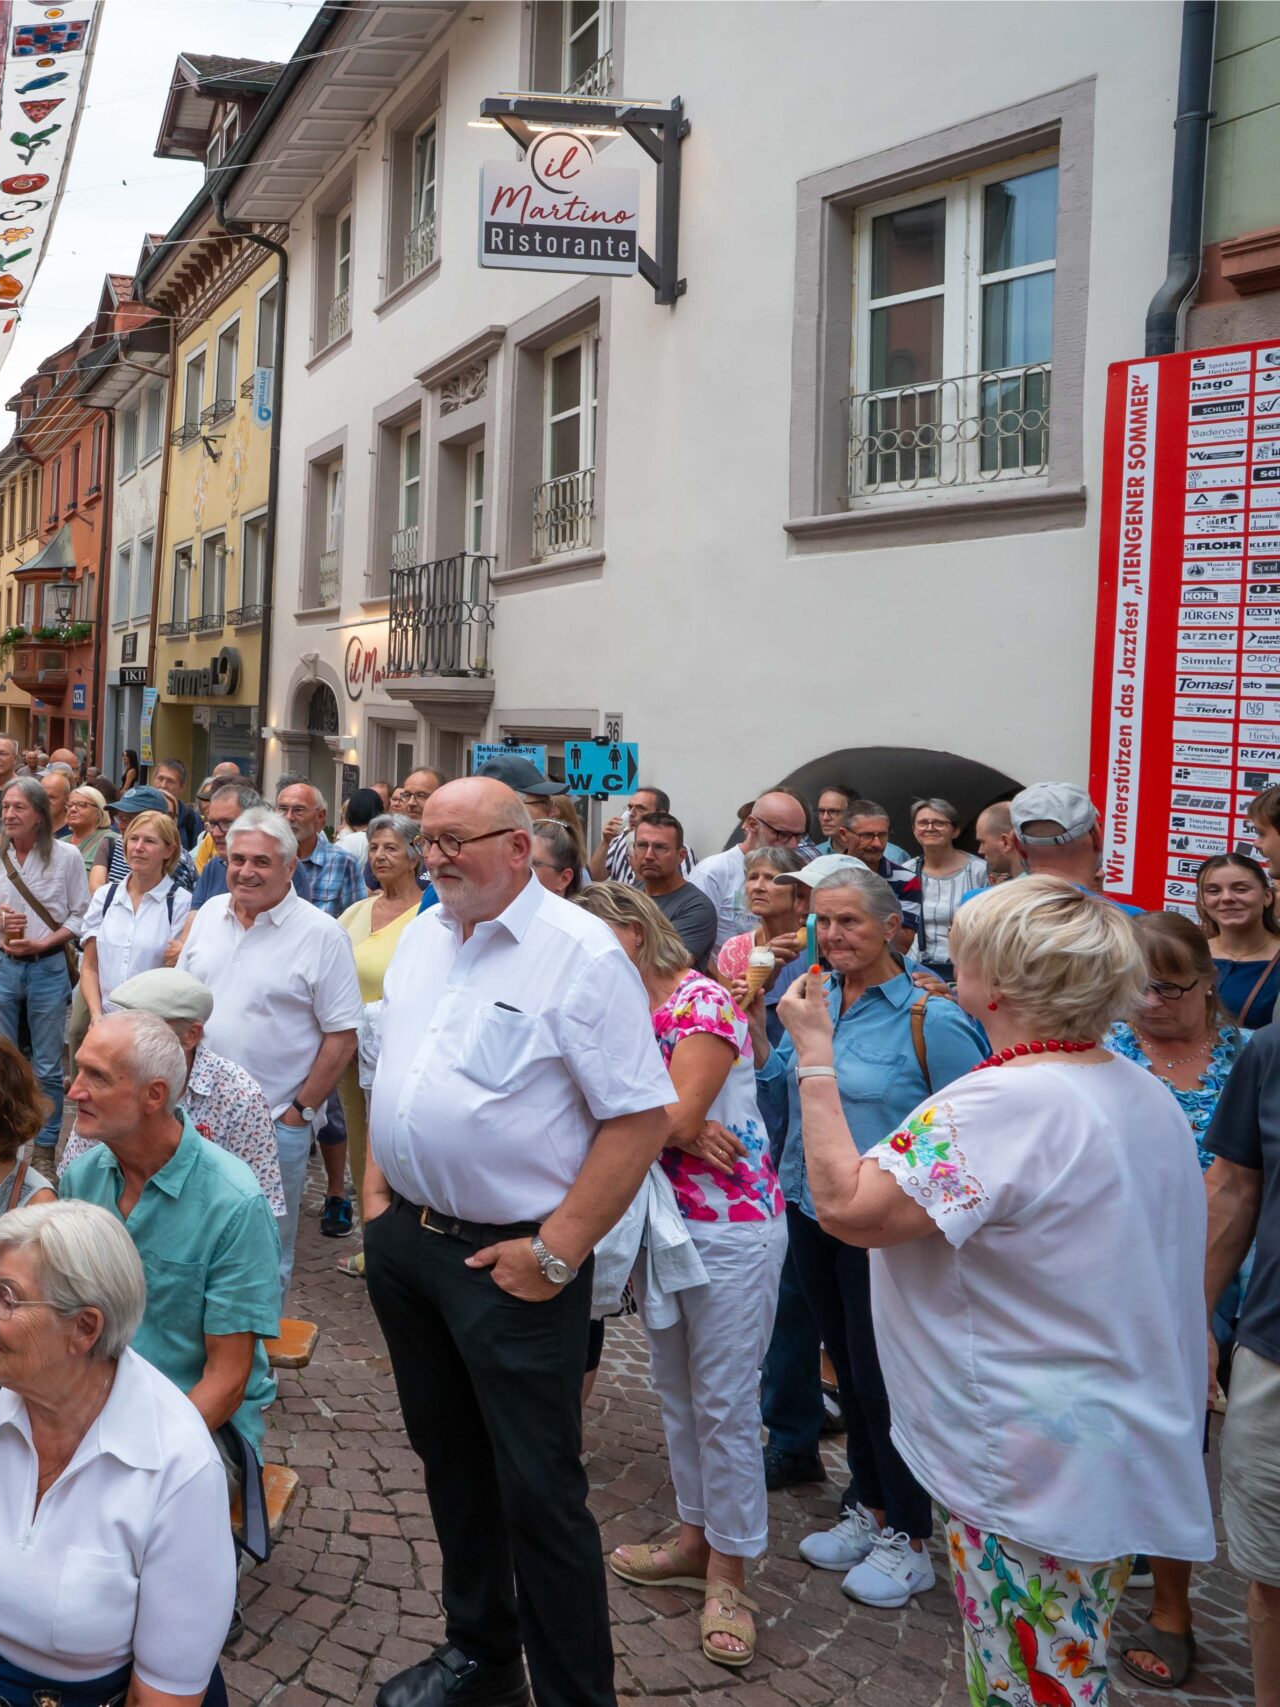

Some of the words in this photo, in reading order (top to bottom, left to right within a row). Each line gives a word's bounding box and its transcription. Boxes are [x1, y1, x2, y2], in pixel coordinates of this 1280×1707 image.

[544, 146, 580, 179] il
[491, 185, 636, 227] Martino
[491, 227, 630, 258] Ristorante
[1208, 360, 1247, 369] Sparkasse
[1208, 366, 1247, 375] Hochrhein
[1191, 379, 1233, 391] hago
[1202, 404, 1243, 414] SCHLEITH
[1197, 541, 1242, 551] FLOHR
[1184, 592, 1218, 600] KOHL
[1182, 609, 1234, 621] JÜRGENS
[1117, 601, 1139, 678] Jazzfest
[1182, 632, 1234, 641] arzner
[1181, 655, 1233, 665] Simmler
[1178, 678, 1234, 692] Tomasi
[1242, 681, 1262, 689] sto
[1114, 684, 1135, 719] das
[1195, 706, 1232, 715] Tiefert
[606, 721, 620, 743] 36
[477, 745, 537, 755] Behinderten-WC
[1187, 746, 1229, 754] fressnapf
[1111, 724, 1133, 845] unterstützen
[1172, 794, 1227, 810] 2000
[1189, 818, 1222, 826] Treuhand
[1189, 824, 1225, 832] Hochrhein
[1105, 850, 1125, 884] Wir
